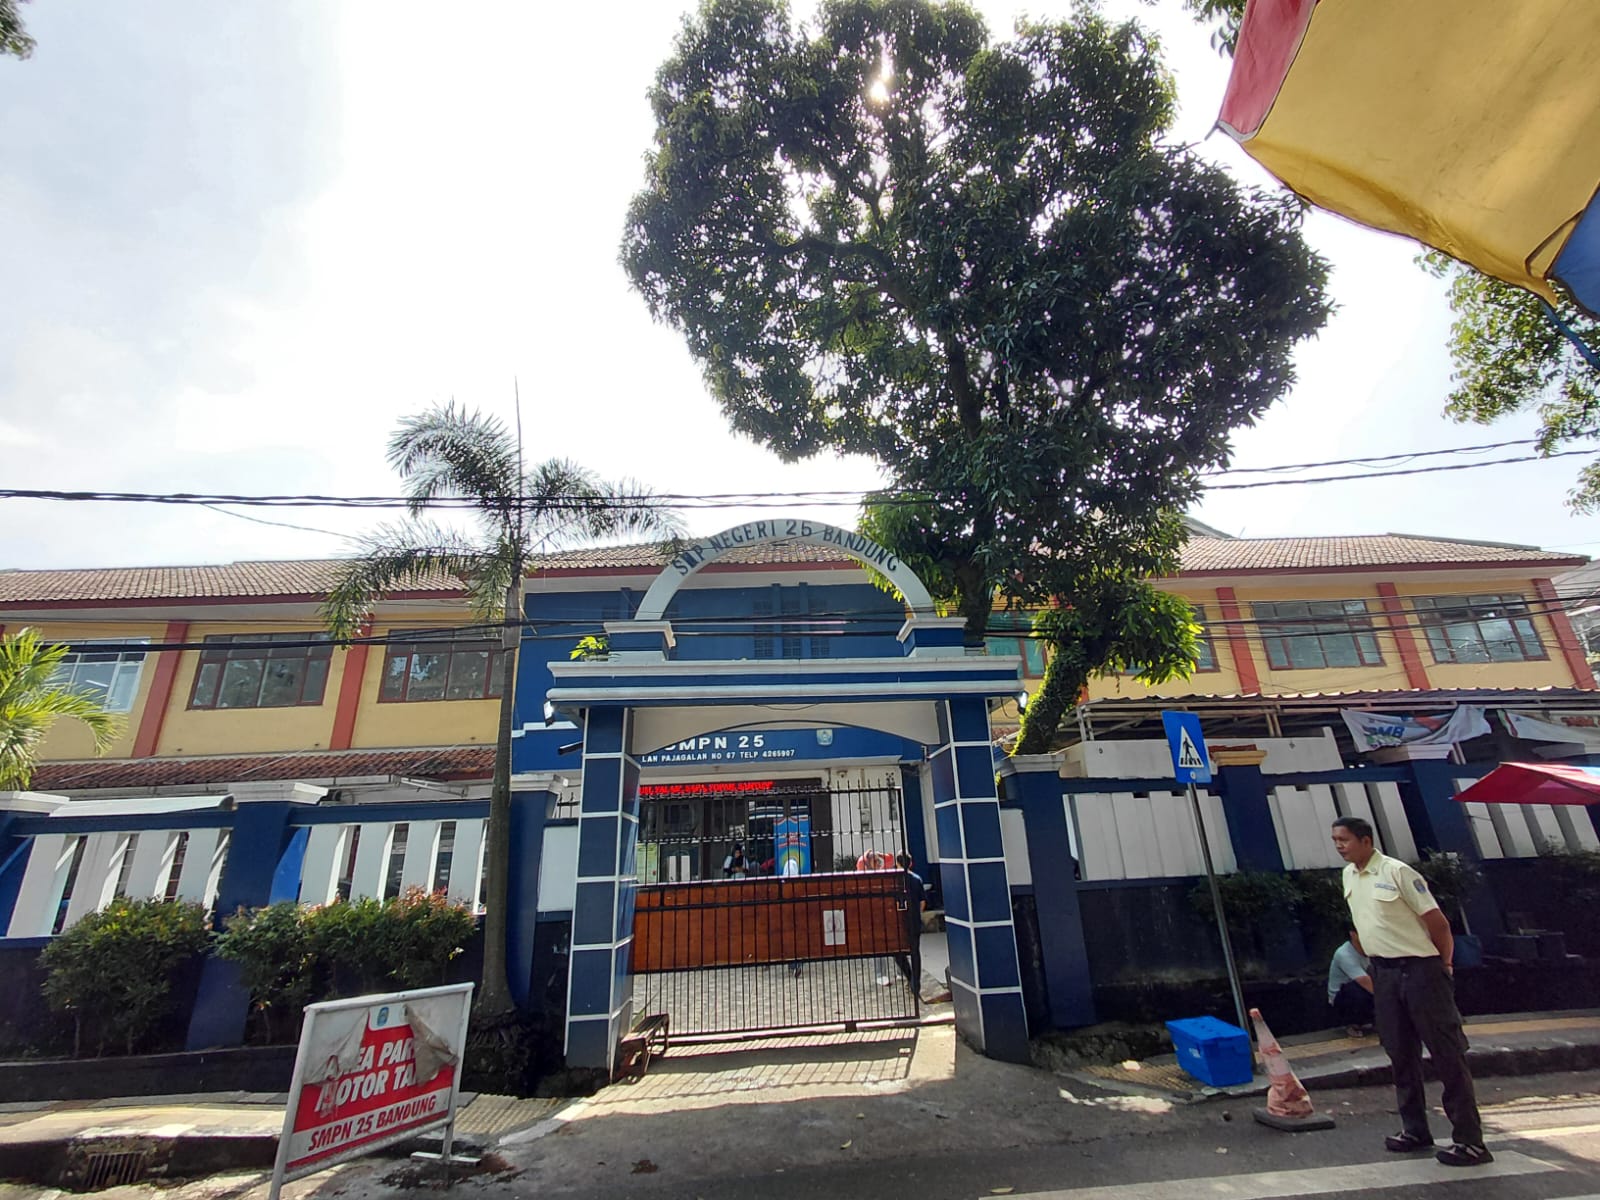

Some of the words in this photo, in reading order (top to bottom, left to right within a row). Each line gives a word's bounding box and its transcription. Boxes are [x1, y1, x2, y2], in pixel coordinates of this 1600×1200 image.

[709, 519, 776, 553] NEGERI
[786, 519, 812, 537] 25
[823, 527, 900, 572] BANDUNG
[738, 735, 764, 748] 25
[641, 755, 658, 763] LAN
[661, 752, 707, 762] PAJAGALAN
[740, 751, 758, 759] TELP
[377, 1038, 415, 1067] PAR
[308, 1121, 353, 1152] SMPN
[356, 1114, 374, 1135] 25
[376, 1095, 436, 1128] BANDUNG
